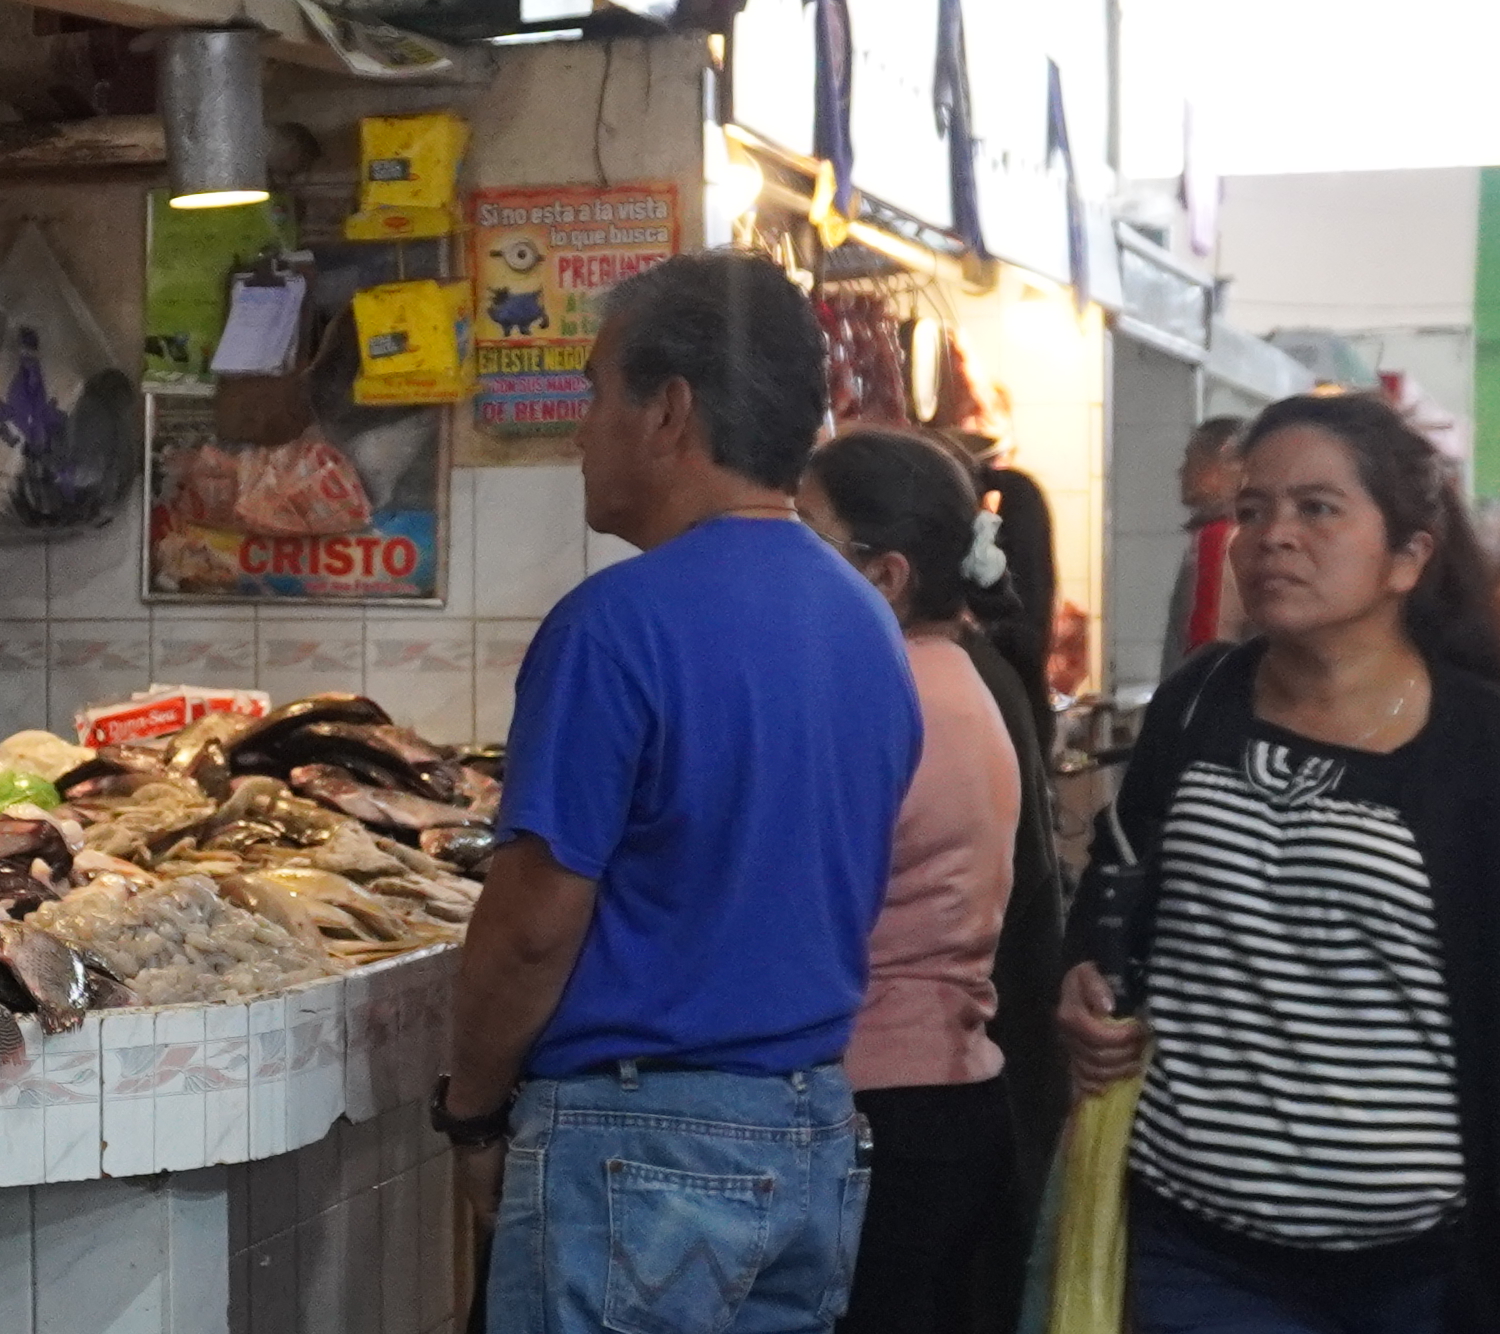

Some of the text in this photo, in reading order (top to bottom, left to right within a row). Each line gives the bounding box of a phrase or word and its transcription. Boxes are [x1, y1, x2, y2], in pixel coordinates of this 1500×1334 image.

[500, 205, 528, 225] no
[531, 201, 574, 224] esta
[578, 203, 591, 222] a
[593, 199, 613, 221] la
[617, 195, 668, 221] vista
[550, 224, 669, 251] lo que busca
[558, 252, 666, 289] PREGUNT
[502, 348, 541, 372] ESTE
[238, 535, 418, 578] CRISTO
